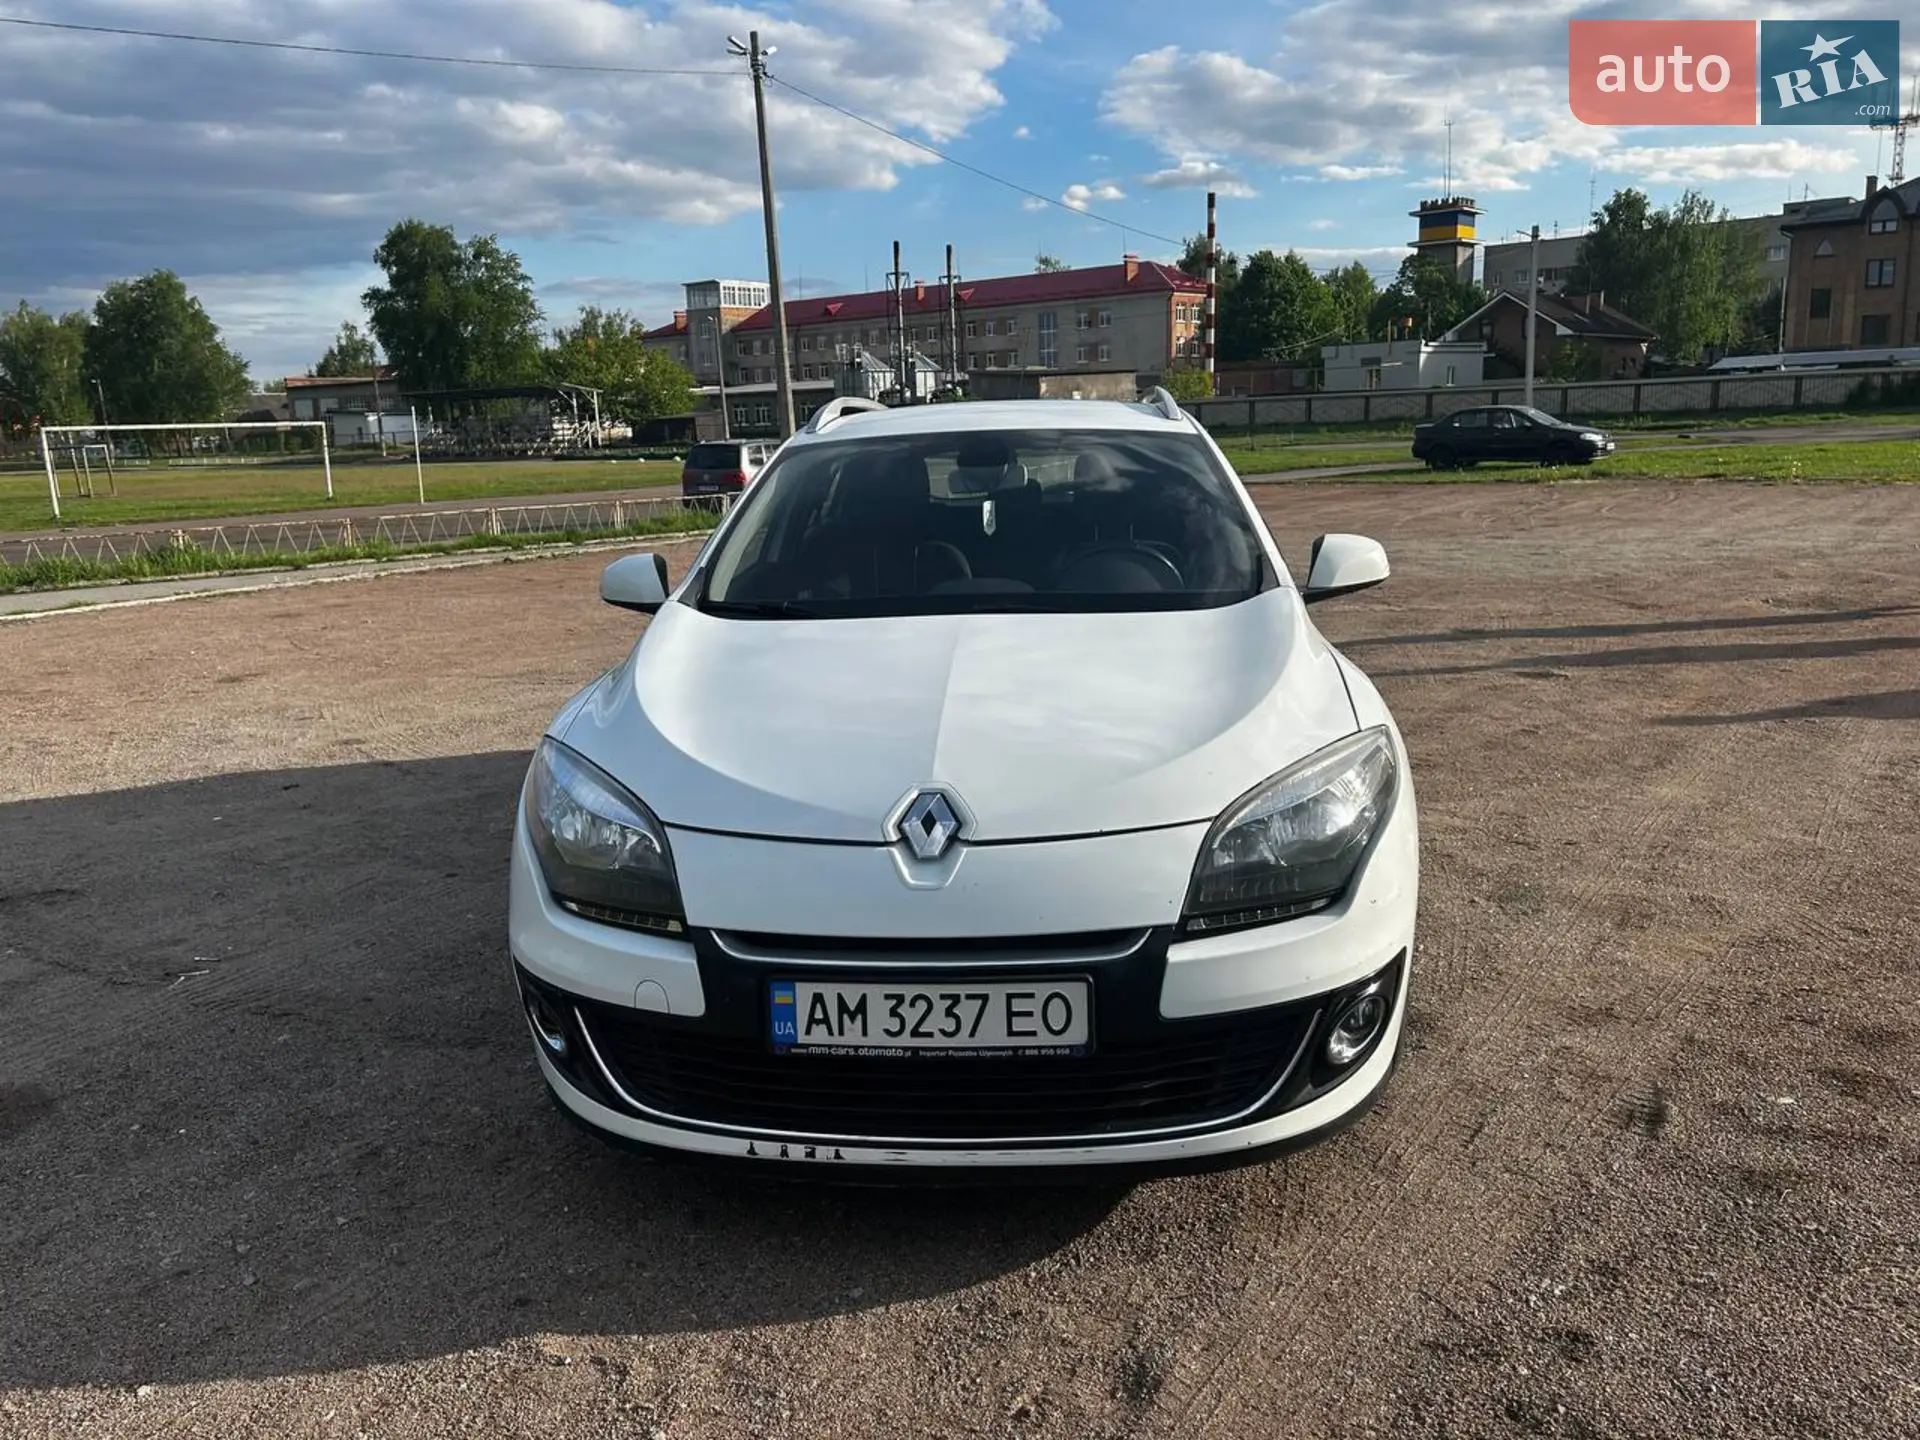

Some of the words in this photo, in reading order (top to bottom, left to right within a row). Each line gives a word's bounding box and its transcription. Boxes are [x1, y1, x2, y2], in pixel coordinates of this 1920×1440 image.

[774, 1021, 795, 1036] UA
[804, 992, 869, 1037] AM
[882, 992, 990, 1039] 3237
[1005, 990, 1073, 1037] EO
